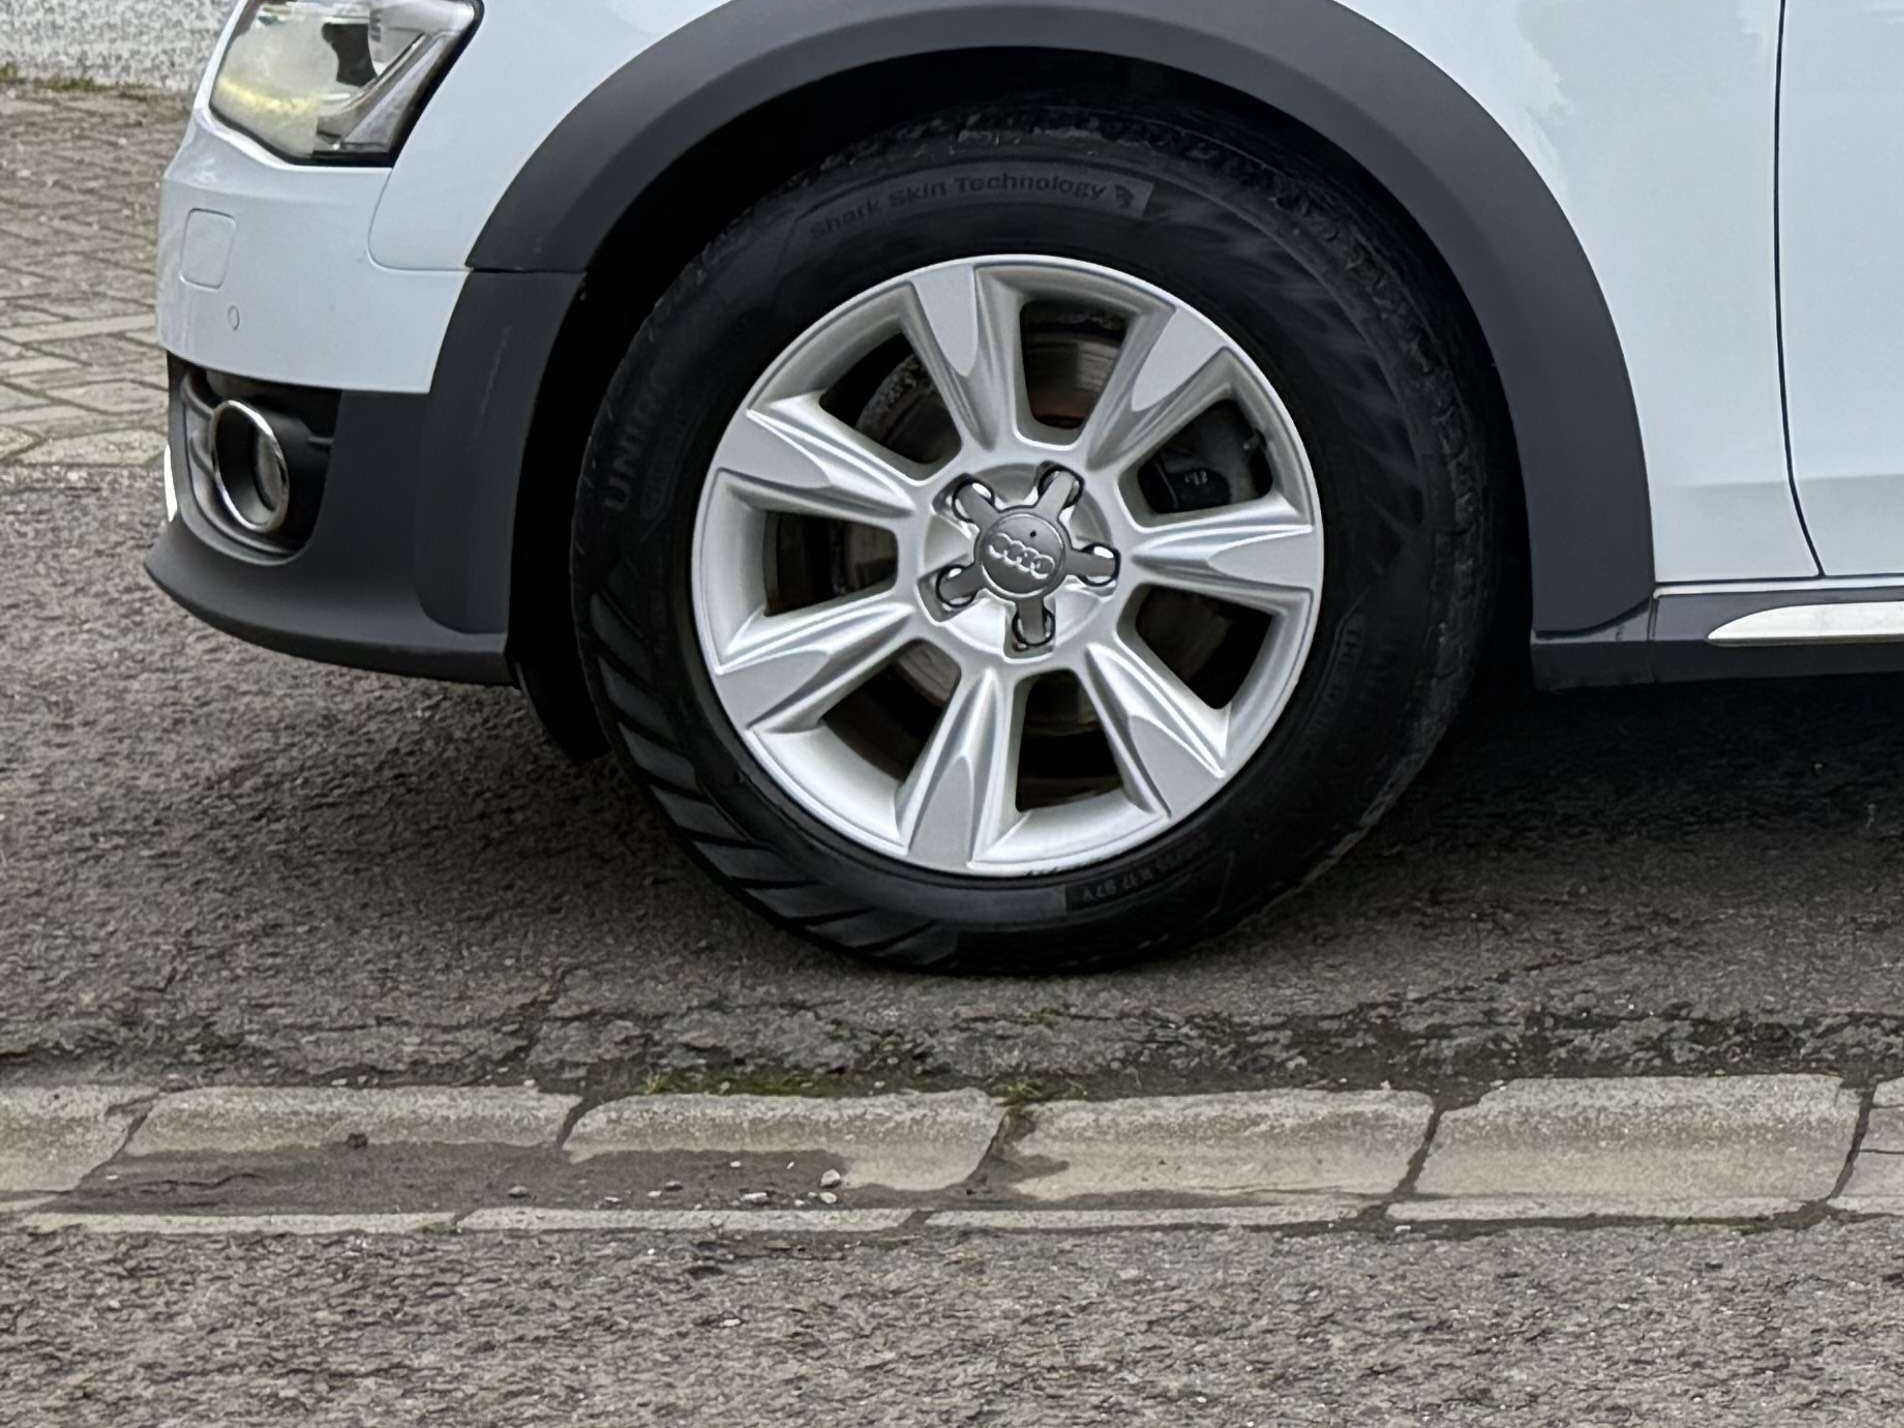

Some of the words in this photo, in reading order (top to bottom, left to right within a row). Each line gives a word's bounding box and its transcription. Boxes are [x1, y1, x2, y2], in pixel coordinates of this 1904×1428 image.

[808, 197, 882, 241] Shark
[889, 181, 947, 209] Skin
[954, 172, 1108, 203] Technology
